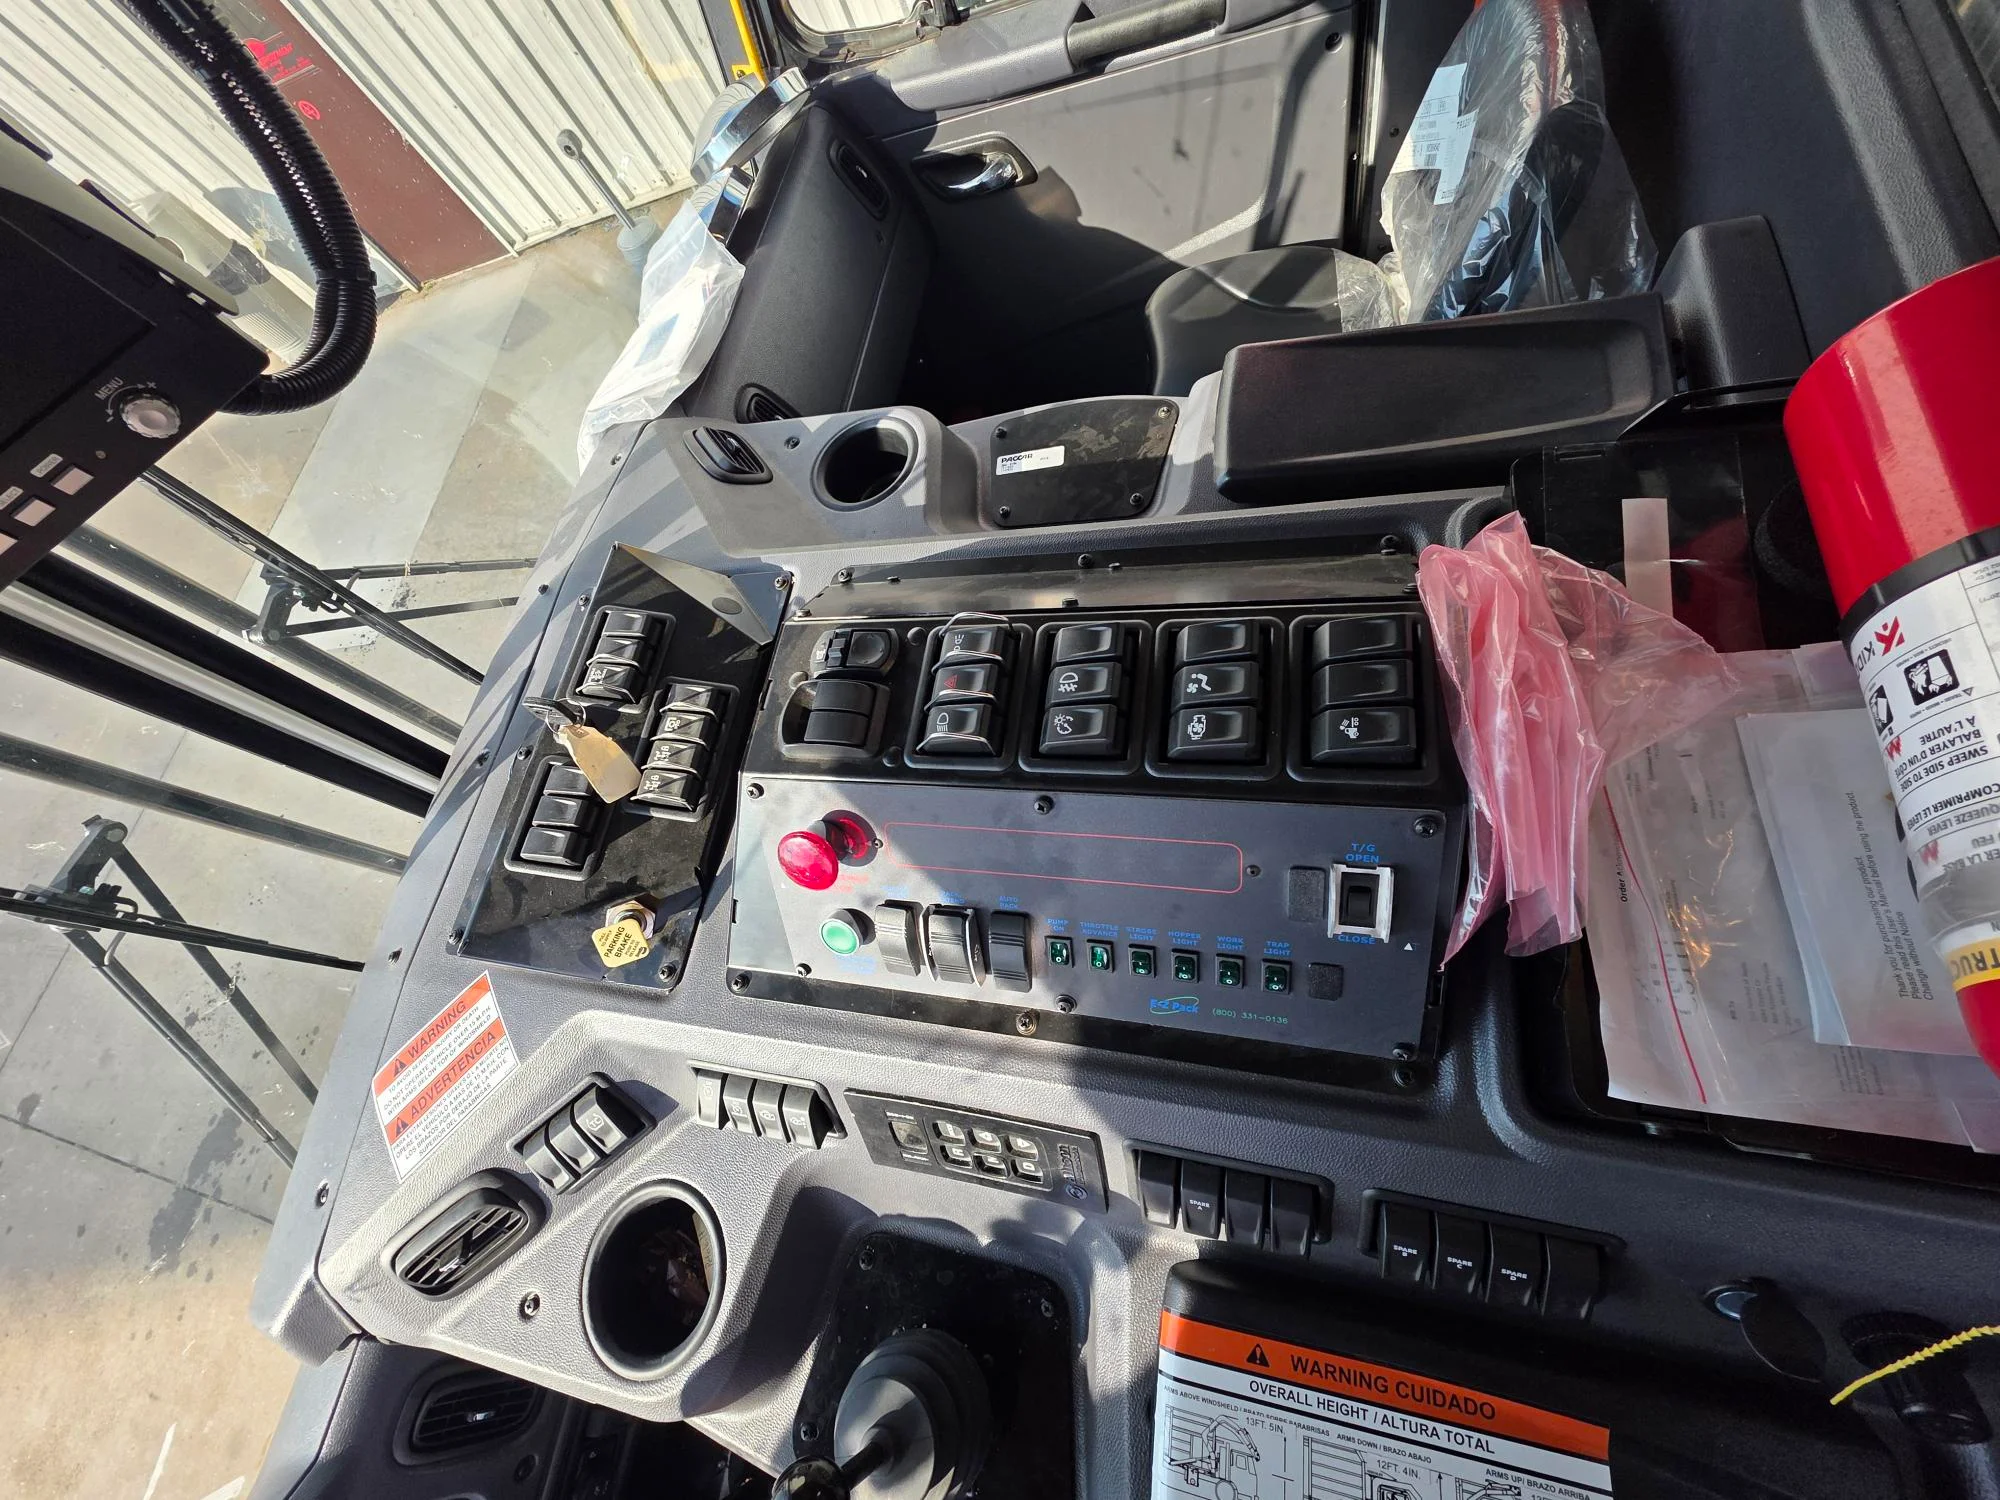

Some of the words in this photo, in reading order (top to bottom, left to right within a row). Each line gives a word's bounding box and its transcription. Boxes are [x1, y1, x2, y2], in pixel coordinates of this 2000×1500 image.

[94, 376, 124, 401] MENU
[1001, 453, 1033, 464] PACCAR
[1918, 718, 1963, 745] L'AUTRE
[1928, 728, 1981, 755] BALAYER
[1907, 749, 1926, 766] D'UN
[1947, 745, 1988, 766] SWEEP
[1912, 768, 1923, 782] TO
[1924, 759, 1944, 774] SIDE
[1899, 777, 1912, 792] SIDE
[1931, 782, 2000, 812] COMPRIMER
[1922, 805, 1931, 815] LE
[1855, 820, 1864, 832] the
[1926, 818, 1952, 836] LEVER
[1351, 843, 1376, 853] T/G
[1859, 832, 1872, 853] using
[1970, 832, 1994, 848] FEU
[1345, 853, 1379, 863] OPEN
[1865, 853, 1879, 878] before
[1967, 853, 1982, 866] LA
[1620, 876, 1629, 903] Order
[1866, 884, 1874, 899] our
[1874, 878, 1888, 908] Manual
[999, 895, 1019, 903] AUTO
[1047, 918, 1069, 927] PUMP
[1080, 921, 1119, 931] THROTTLE
[1870, 898, 1891, 943] purchasing
[1896, 910, 1910, 937] Notice
[603, 926, 625, 958] PARKING
[1081, 929, 1118, 938] ADVANCE
[1129, 933, 1154, 941] LIGHT
[1167, 930, 1201, 940] HOPPER
[1173, 938, 1198, 946] LIGHT
[1217, 935, 1244, 944] WORK
[1338, 934, 1376, 945] CLOSE
[1892, 934, 1903, 950] this
[614, 932, 633, 958] BRAKE
[1217, 943, 1244, 951] LIGHT
[1264, 947, 1292, 957] LIGHT
[1266, 940, 1290, 949] TRAP
[1883, 942, 1893, 955] for
[1904, 936, 1920, 968] without
[1889, 955, 1901, 972] you
[1898, 950, 1910, 971] read
[1894, 972, 1909, 999] Thank
[1906, 971, 1921, 1000] Please
[1916, 967, 1934, 1001] Change
[1212, 1008, 1237, 1019] (800)
[1241, 1011, 1289, 1024] 331-0136
[407, 998, 466, 1061] WARNING
[388, 1083, 396, 1095] TO
[395, 1069, 412, 1088] AVOID
[411, 1046, 435, 1072] SERIOUS
[433, 1030, 452, 1051] INJURY
[452, 1021, 462, 1033] OR
[460, 1004, 479, 1025] DEATH
[383, 1098, 393, 1111] DO
[392, 1088, 404, 1103] NOT
[404, 1063, 429, 1091] OPERATE
[429, 1041, 453, 1066] VEHICLE
[452, 1025, 469, 1044] OVER
[468, 1018, 475, 1029] 15
[386, 1099, 401, 1117] WITH
[400, 1084, 417, 1103] ARMS
[417, 1064, 437, 1087] BELOW
[437, 1053, 449, 1068] TOP
[448, 1045, 457, 1057] OF
[457, 1013, 491, 1048] WINDSHIELD
[408, 1028, 496, 1119] ADVERTENCIA
[405, 1118, 423, 1139] EVITAR
[478, 1045, 499, 1067] MUERTE
[395, 1137, 414, 1159] OPERE
[413, 1130, 421, 1141] EL
[421, 1103, 449, 1133] VEHICULO
[448, 1097, 454, 1107] A
[465, 1078, 474, 1090] DE
[473, 1072, 481, 1082] 15
[496, 1044, 509, 1059] CON
[404, 1144, 417, 1160] LOS
[415, 1123, 439, 1149] BRAZOS
[438, 1111, 451, 1127] POR
[450, 1089, 473, 1114] DEBAJO
[472, 1081, 481, 1093] DE
[480, 1073, 489, 1085] LA
[488, 1056, 507, 1077] PARTE
[418, 1126, 446, 1157] SUPERIOR
[445, 1114, 457, 1130] DEL
[456, 1081, 491, 1119] PARABRISAS
[951, 1147, 964, 1156] R
[1022, 1161, 1035, 1170] D
[1189, 1199, 1210, 1209] SPARE
[1393, 1244, 1418, 1255] SPARE
[1447, 1257, 1473, 1268] SPARE
[1501, 1268, 1528, 1280] SPARE
[1290, 1354, 1389, 1394] WARNING
[1395, 1380, 1496, 1420] CUIDADO
[1164, 1385, 1179, 1396] ARMS
[1179, 1390, 1201, 1402] ABOVE
[1201, 1396, 1239, 1412] WINDSHIELD
[1288, 1419, 1330, 1437] PARABRISAS
[1249, 1380, 1313, 1407] OVERALL
[1317, 1398, 1369, 1421] HEIGHT
[1381, 1413, 1440, 1440] ALTURA
[1444, 1429, 1496, 1455] TOTAL
[1246, 1416, 1266, 1431] 13FT.
[1269, 1422, 1286, 1435] 5IN.
[1336, 1433, 1356, 1445] ARMS
[1357, 1438, 1378, 1450] DOWN
[1383, 1445, 1407, 1458] BRAZO
[1408, 1451, 1432, 1464] ABAJO
[1376, 1459, 1401, 1474] 12FT.
[1402, 1466, 1421, 1481] 4IN.
[1486, 1468, 1510, 1480] ARMS
[1527, 1479, 1556, 1493] BRAZO
[1558, 1488, 1591, 1500] ARRIBA
